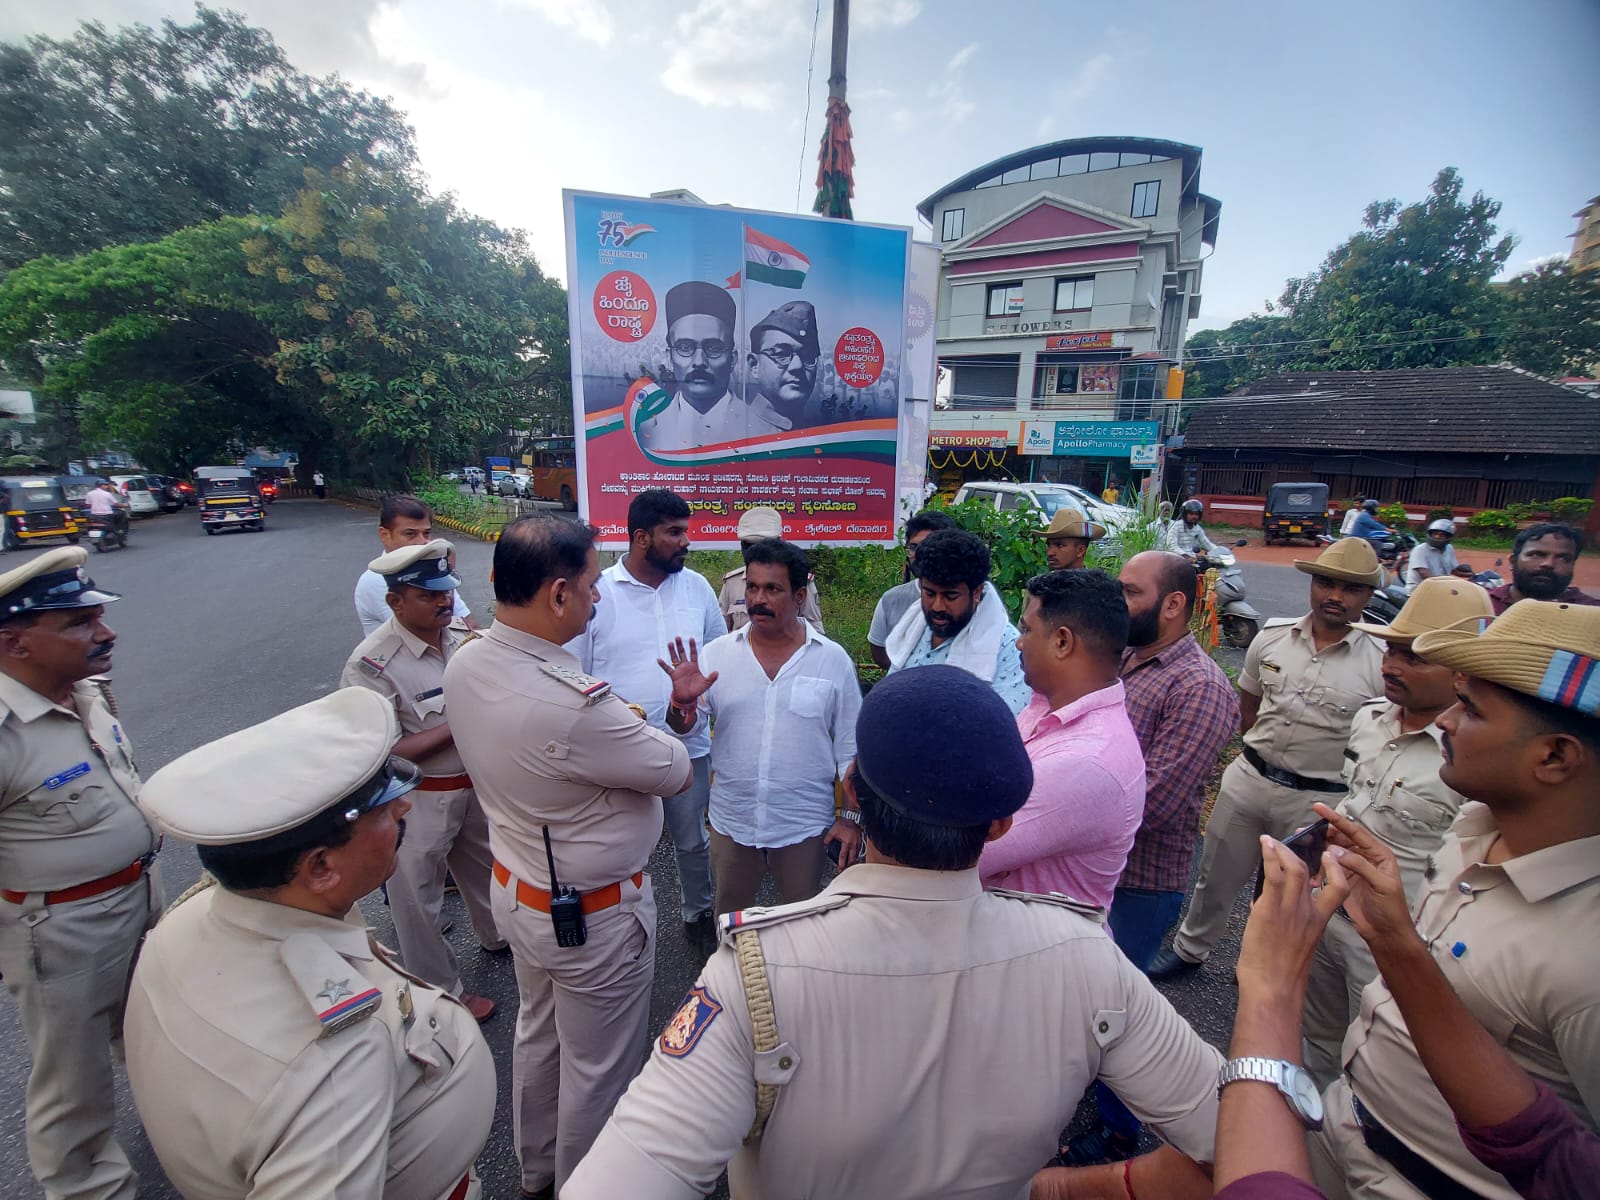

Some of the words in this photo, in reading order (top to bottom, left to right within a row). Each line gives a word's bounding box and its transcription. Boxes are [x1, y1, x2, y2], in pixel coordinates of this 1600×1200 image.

[615, 276, 632, 297] ಜೈ
[600, 296, 649, 311] ಹಿಂದೂ
[608, 315, 643, 338] ರಾಷ್ಟ್ರ
[1013, 320, 1073, 334] TOWERS
[931, 436, 962, 446] METRO
